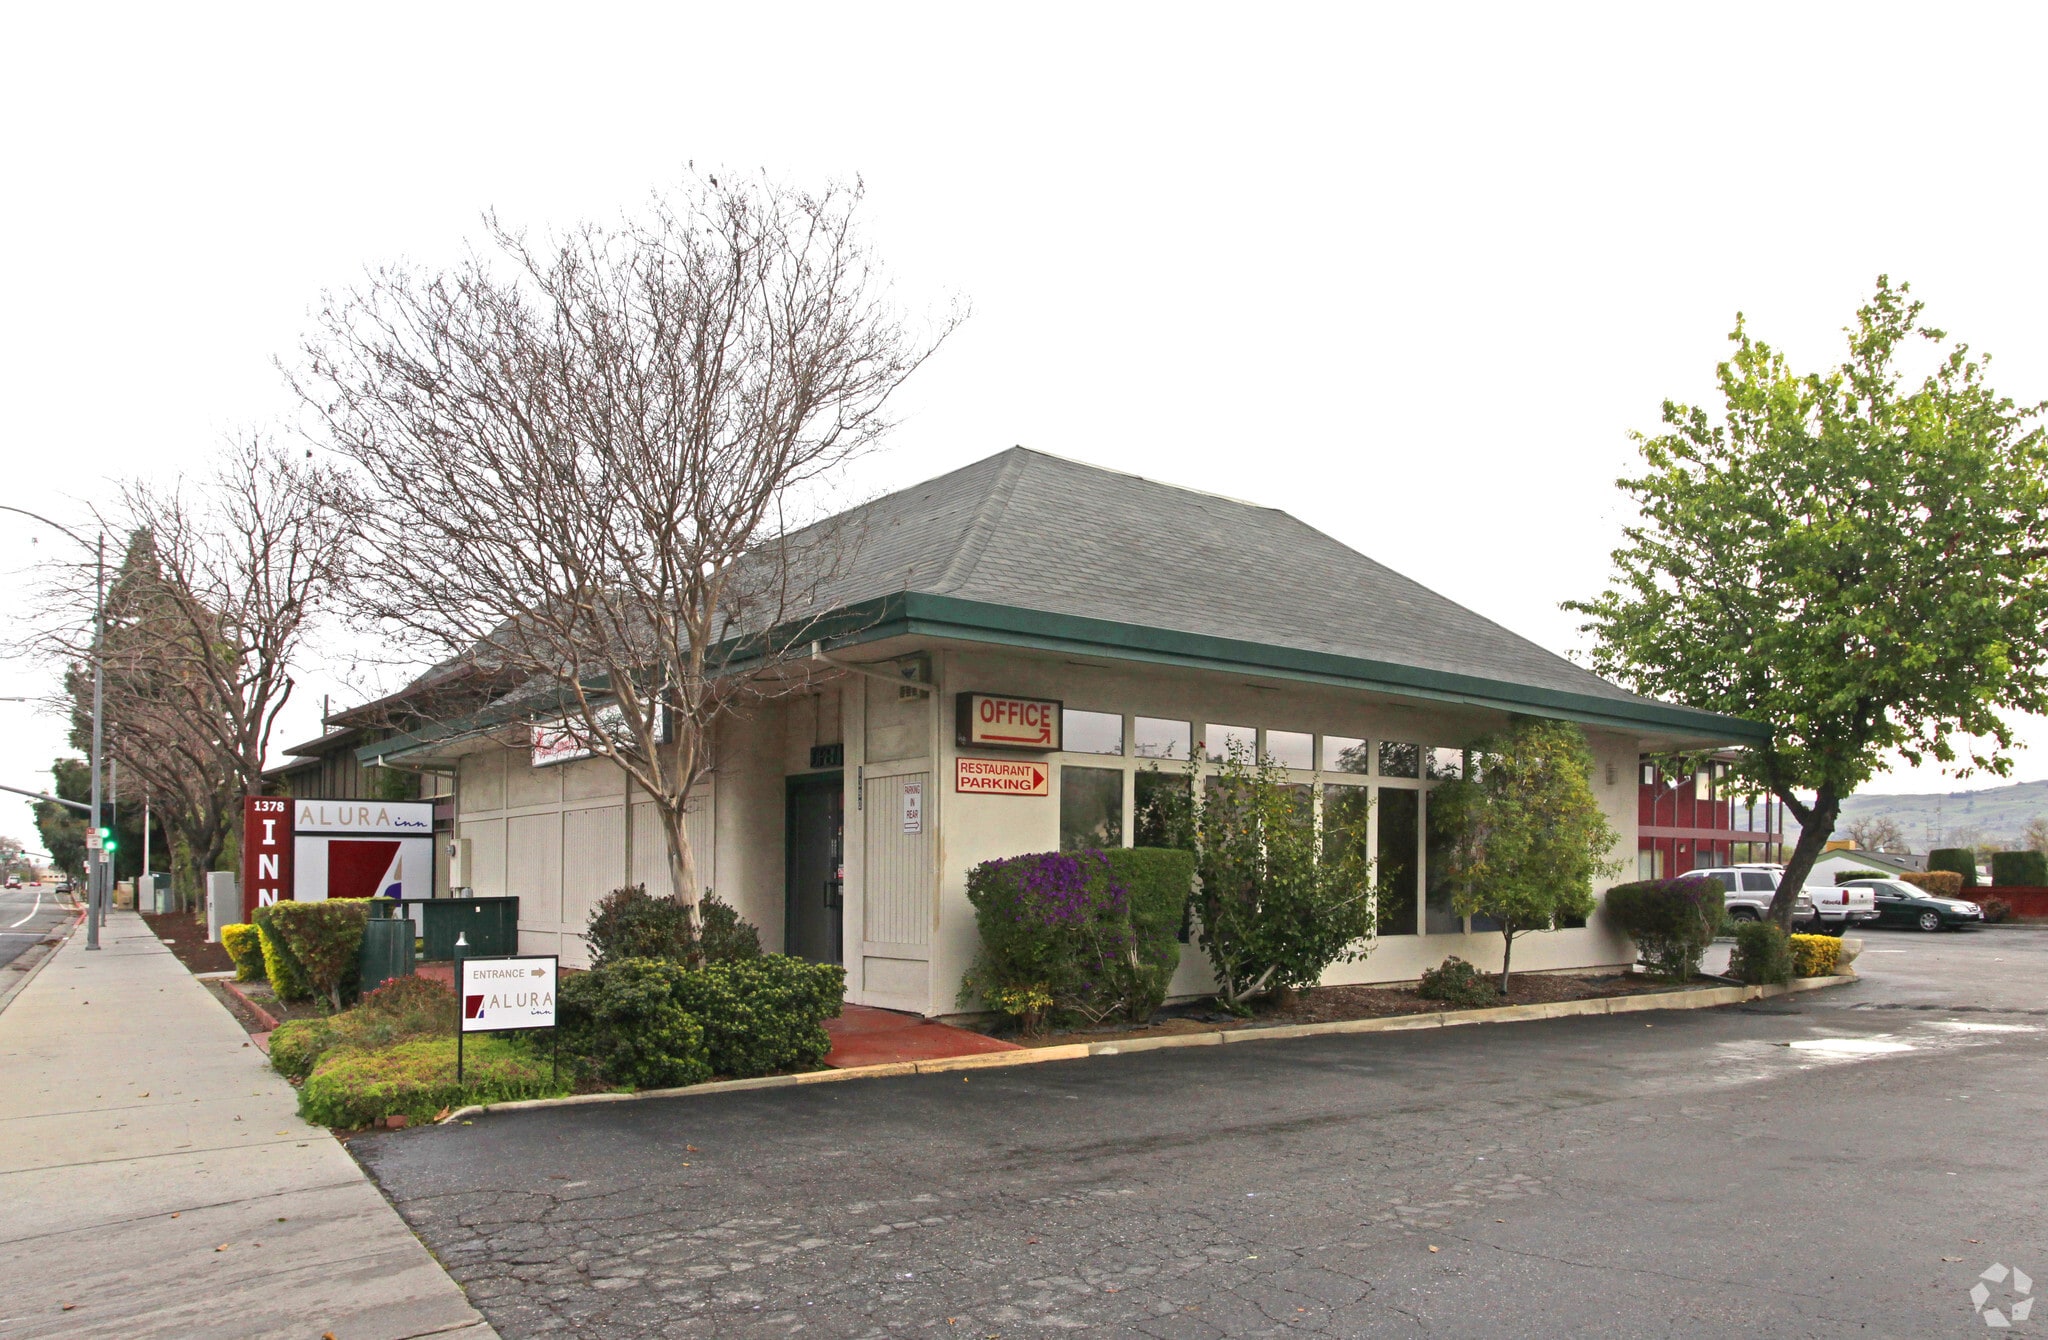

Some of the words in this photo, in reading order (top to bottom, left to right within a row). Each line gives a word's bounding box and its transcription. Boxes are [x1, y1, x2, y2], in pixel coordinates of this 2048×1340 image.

[980, 698, 1051, 727] OFFICE
[960, 762, 1031, 776] RESTAURANT
[960, 776, 1031, 790] PARKING
[254, 800, 285, 812] 1378
[299, 805, 391, 826] ALURA
[394, 817, 428, 828] inn
[258, 819, 279, 908] INN
[473, 968, 525, 980] ENTRANCE
[489, 991, 553, 1009] ALURA
[530, 1007, 553, 1015] inn
